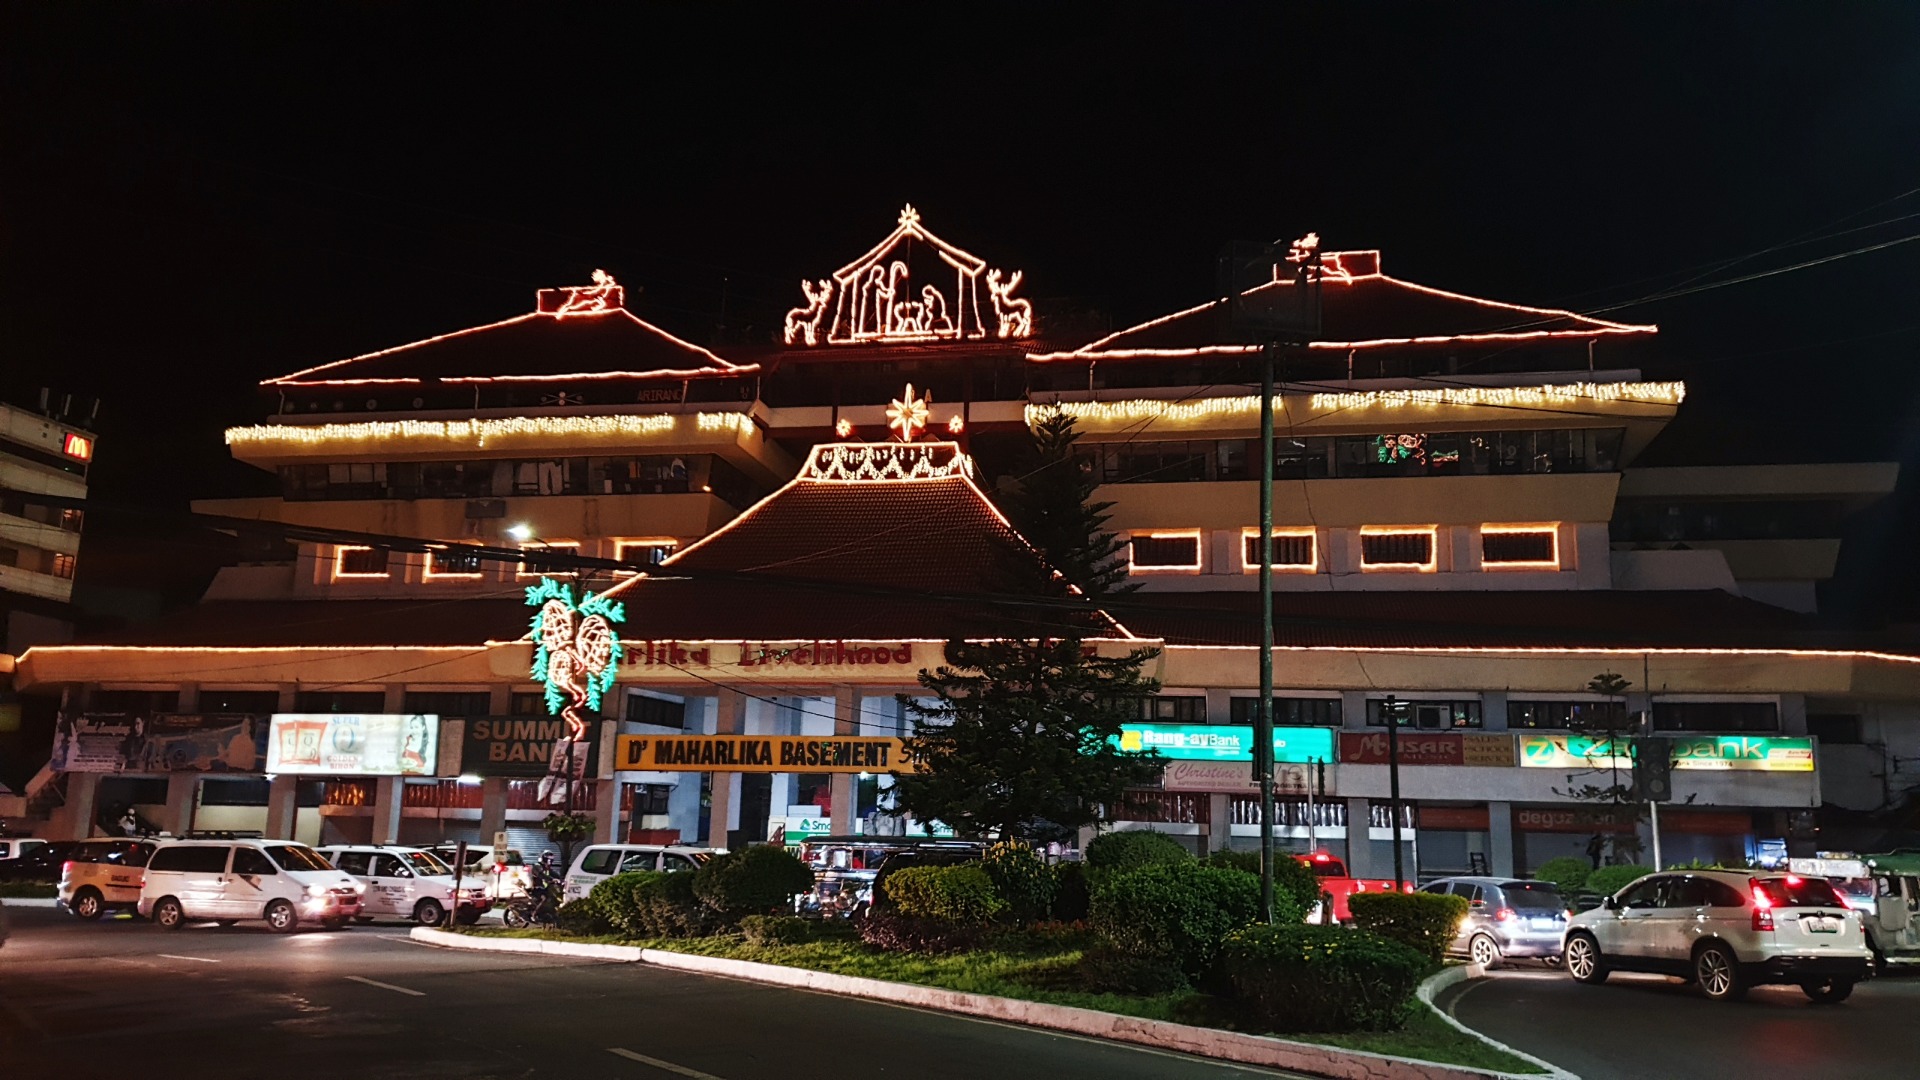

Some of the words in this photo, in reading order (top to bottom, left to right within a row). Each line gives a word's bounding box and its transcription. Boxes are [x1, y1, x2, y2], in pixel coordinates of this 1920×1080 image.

[737, 640, 912, 666] Livelihood
[489, 741, 557, 763] BAN
[654, 740, 772, 766] MAHARLIKA
[780, 741, 891, 767] BASEMENT
[1174, 763, 1243, 780] Christine's
[1692, 760, 1713, 768] Since
[1715, 760, 1733, 768] 1974
